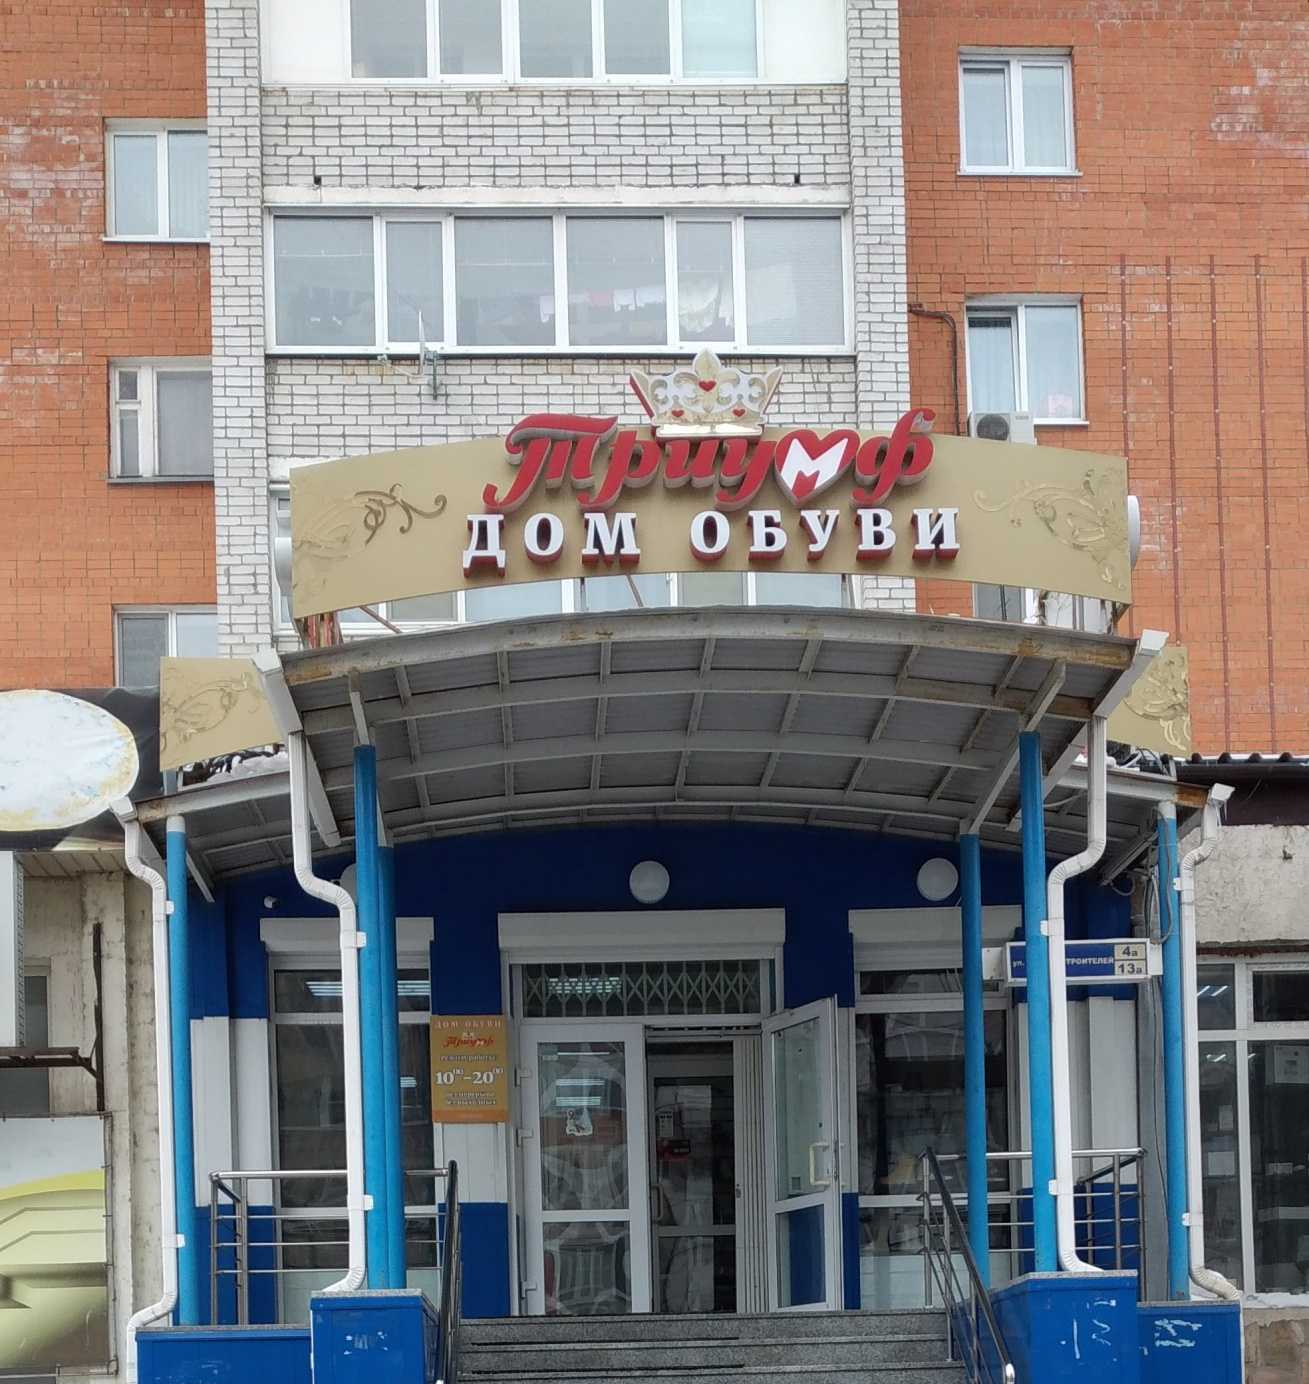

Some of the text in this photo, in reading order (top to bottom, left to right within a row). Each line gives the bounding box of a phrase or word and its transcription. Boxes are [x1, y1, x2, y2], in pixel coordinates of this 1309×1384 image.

[483, 407, 937, 513] Триумф
[463, 507, 961, 578] ДОМ ОБУВИ
[1065, 955, 1114, 966] ТРОИТЕЛЕЙ
